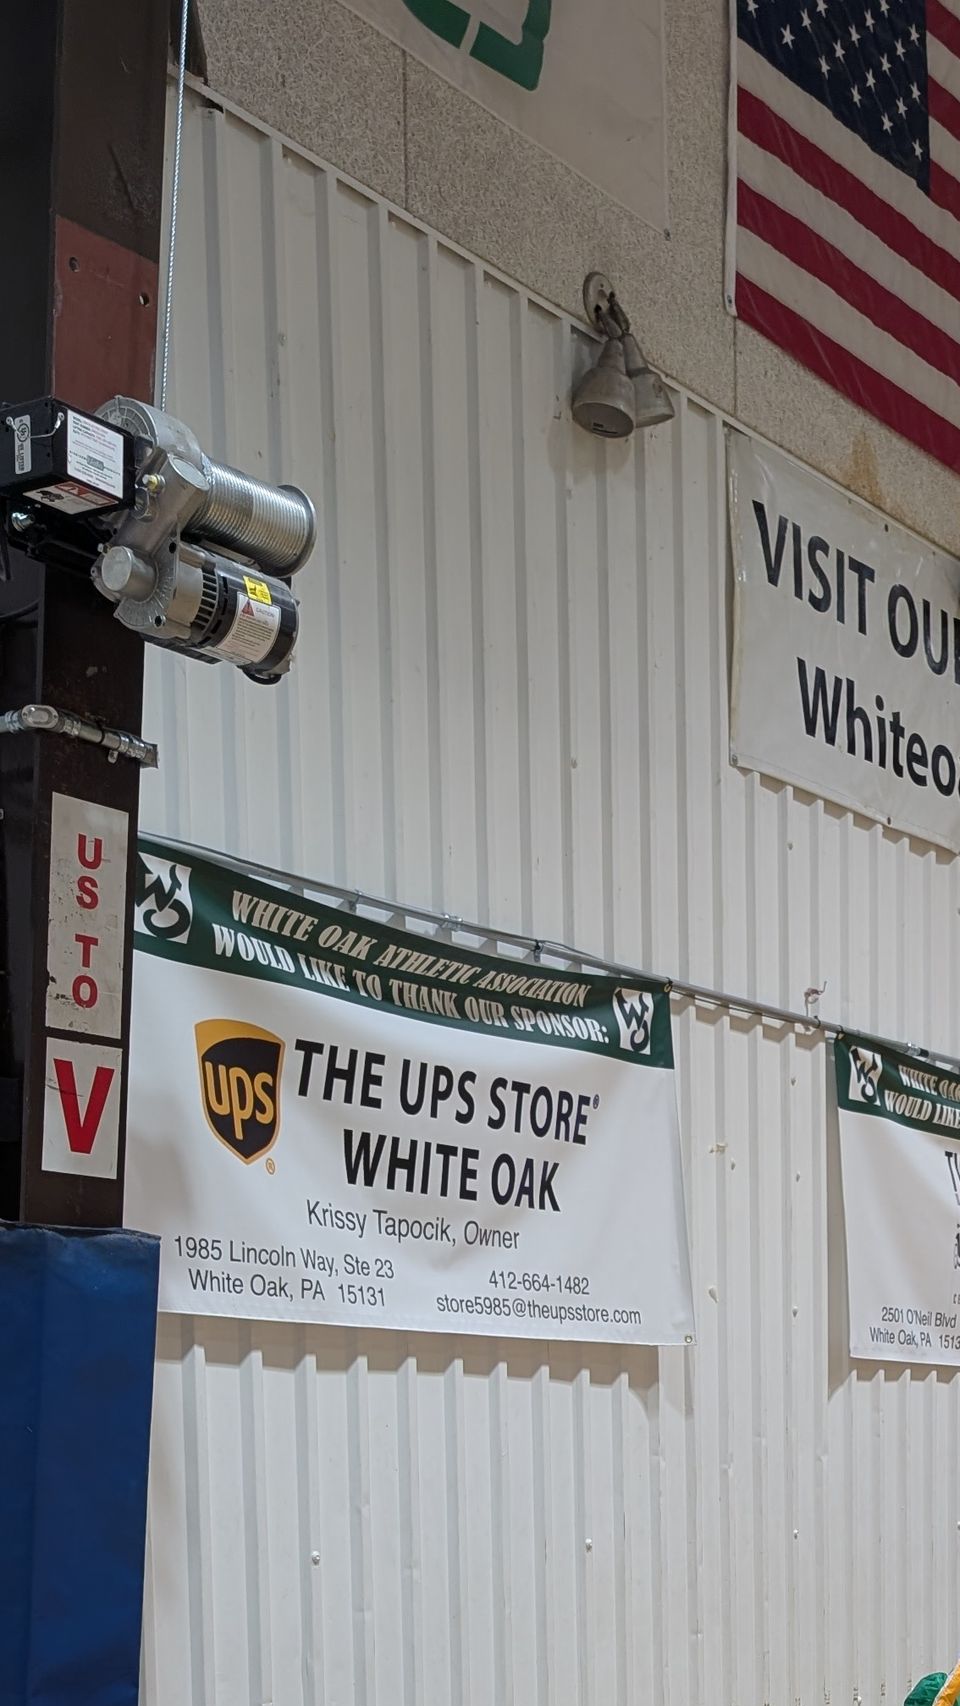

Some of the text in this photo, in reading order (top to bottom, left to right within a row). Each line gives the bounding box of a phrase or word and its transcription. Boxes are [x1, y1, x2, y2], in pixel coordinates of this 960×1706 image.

[752, 499, 875, 636] VISIT
[232, 890, 592, 1007] WHITE OAK ATHLETIC ASSOCIATION
[212, 923, 610, 1043] WOULD LIKE TO THANK OUR SPONSOR:
[204, 1061, 274, 1140] ups
[294, 1038, 386, 1109] THE
[399, 1058, 477, 1124] UPS
[899, 1065, 938, 1096] WHITE
[53, 1058, 115, 1155] V
[884, 1089, 933, 1121] WOULD
[343, 1128, 561, 1212] WHITE OAK
[306, 1199, 520, 1249] Krissy Tapocik, Owner
[174, 1235, 395, 1279] 1985 Lincoln Way, Ste 23
[188, 1268, 386, 1307] White Oak, PA 15131
[489, 1270, 591, 1295] 412-664-1482
[436, 1294, 642, 1325] store5985@theupsstore.com
[881, 1306, 905, 1324] 2501
[934, 1311, 957, 1329] Blvd
[869, 1326, 896, 1345] White
[897, 1329, 919, 1348] Oak,
[919, 1332, 931, 1347] PA
